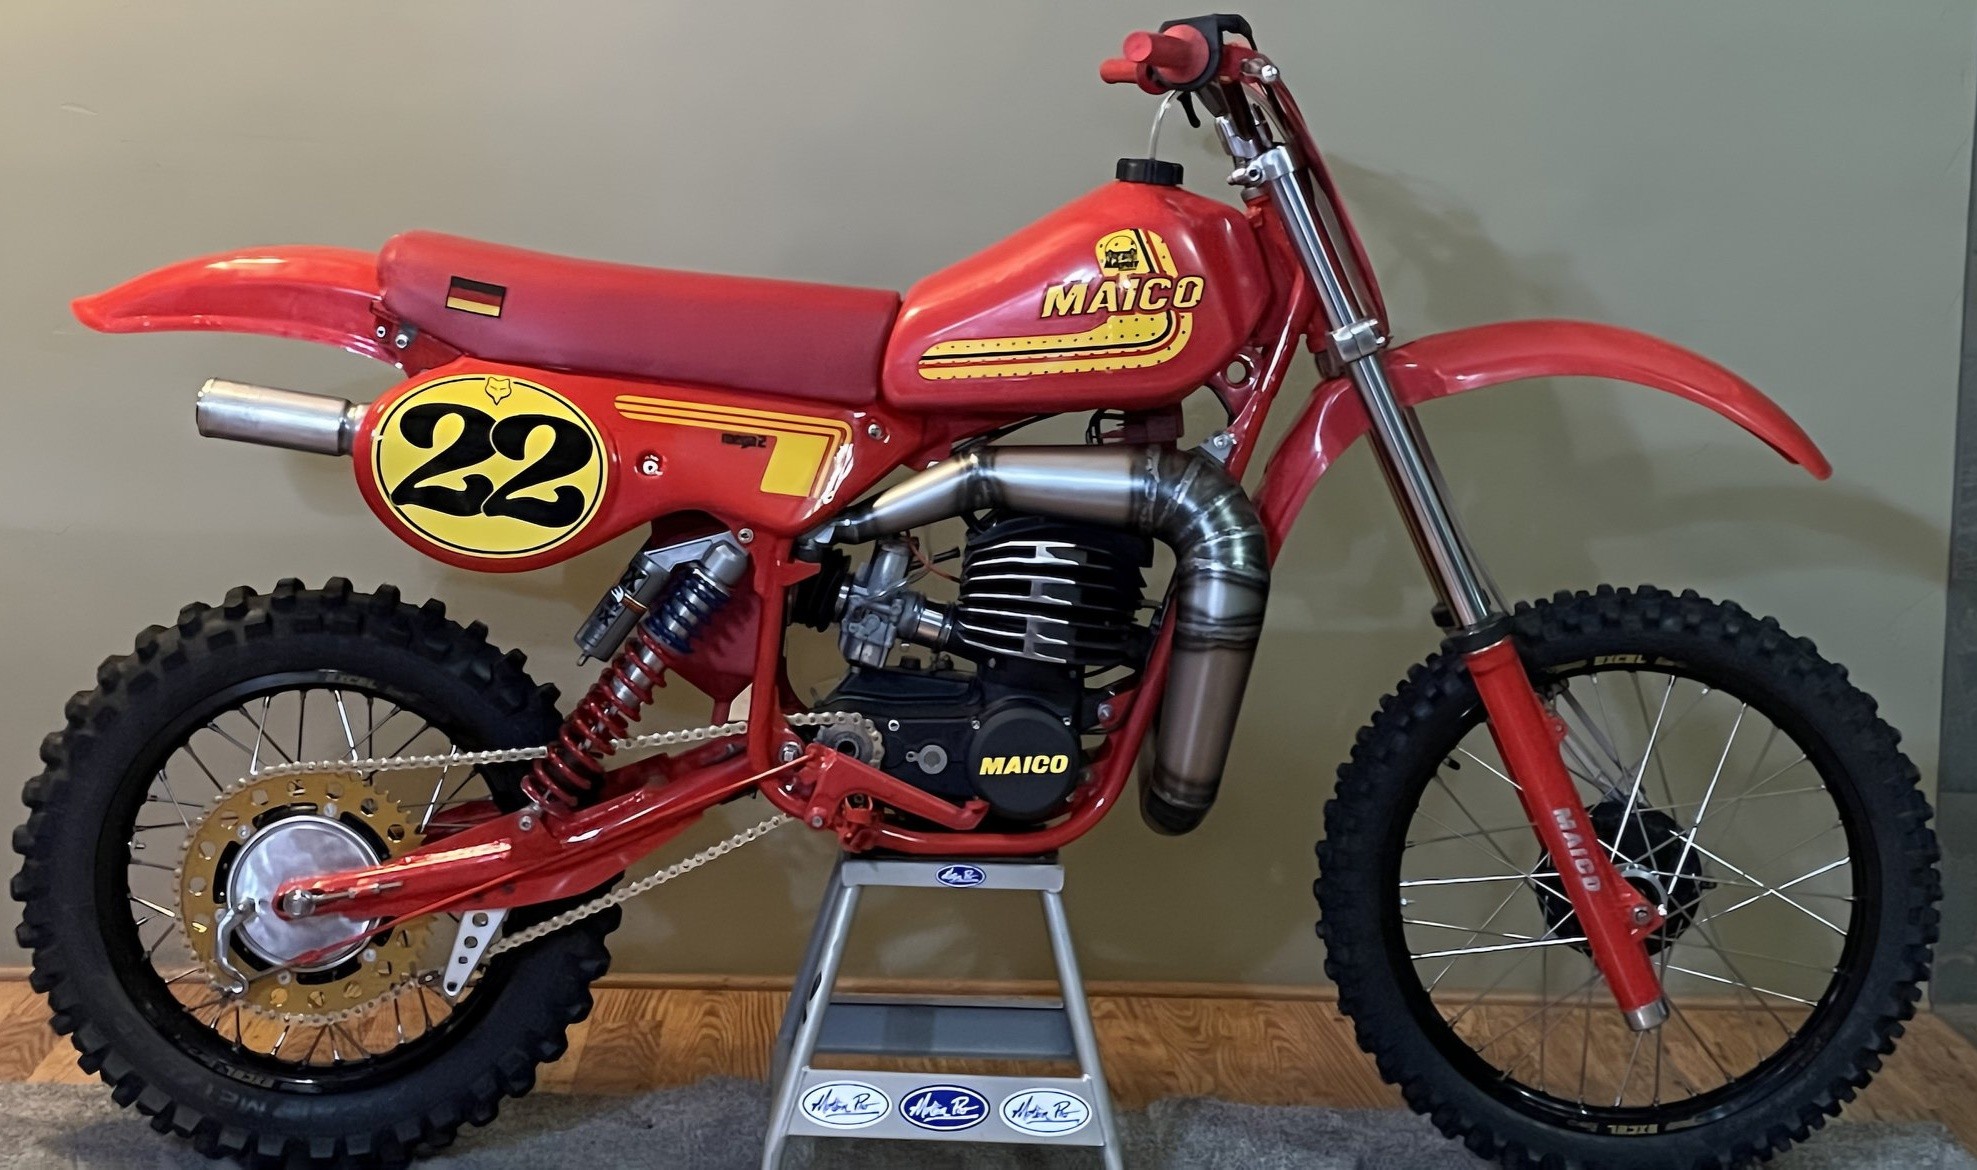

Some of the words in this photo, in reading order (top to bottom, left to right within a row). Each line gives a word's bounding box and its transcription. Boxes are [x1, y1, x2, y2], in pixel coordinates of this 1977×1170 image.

[1040, 275, 1205, 319] MAICO
[391, 402, 593, 528] 22
[979, 754, 1069, 775] MAICO
[1552, 807, 1601, 892] MAICO
